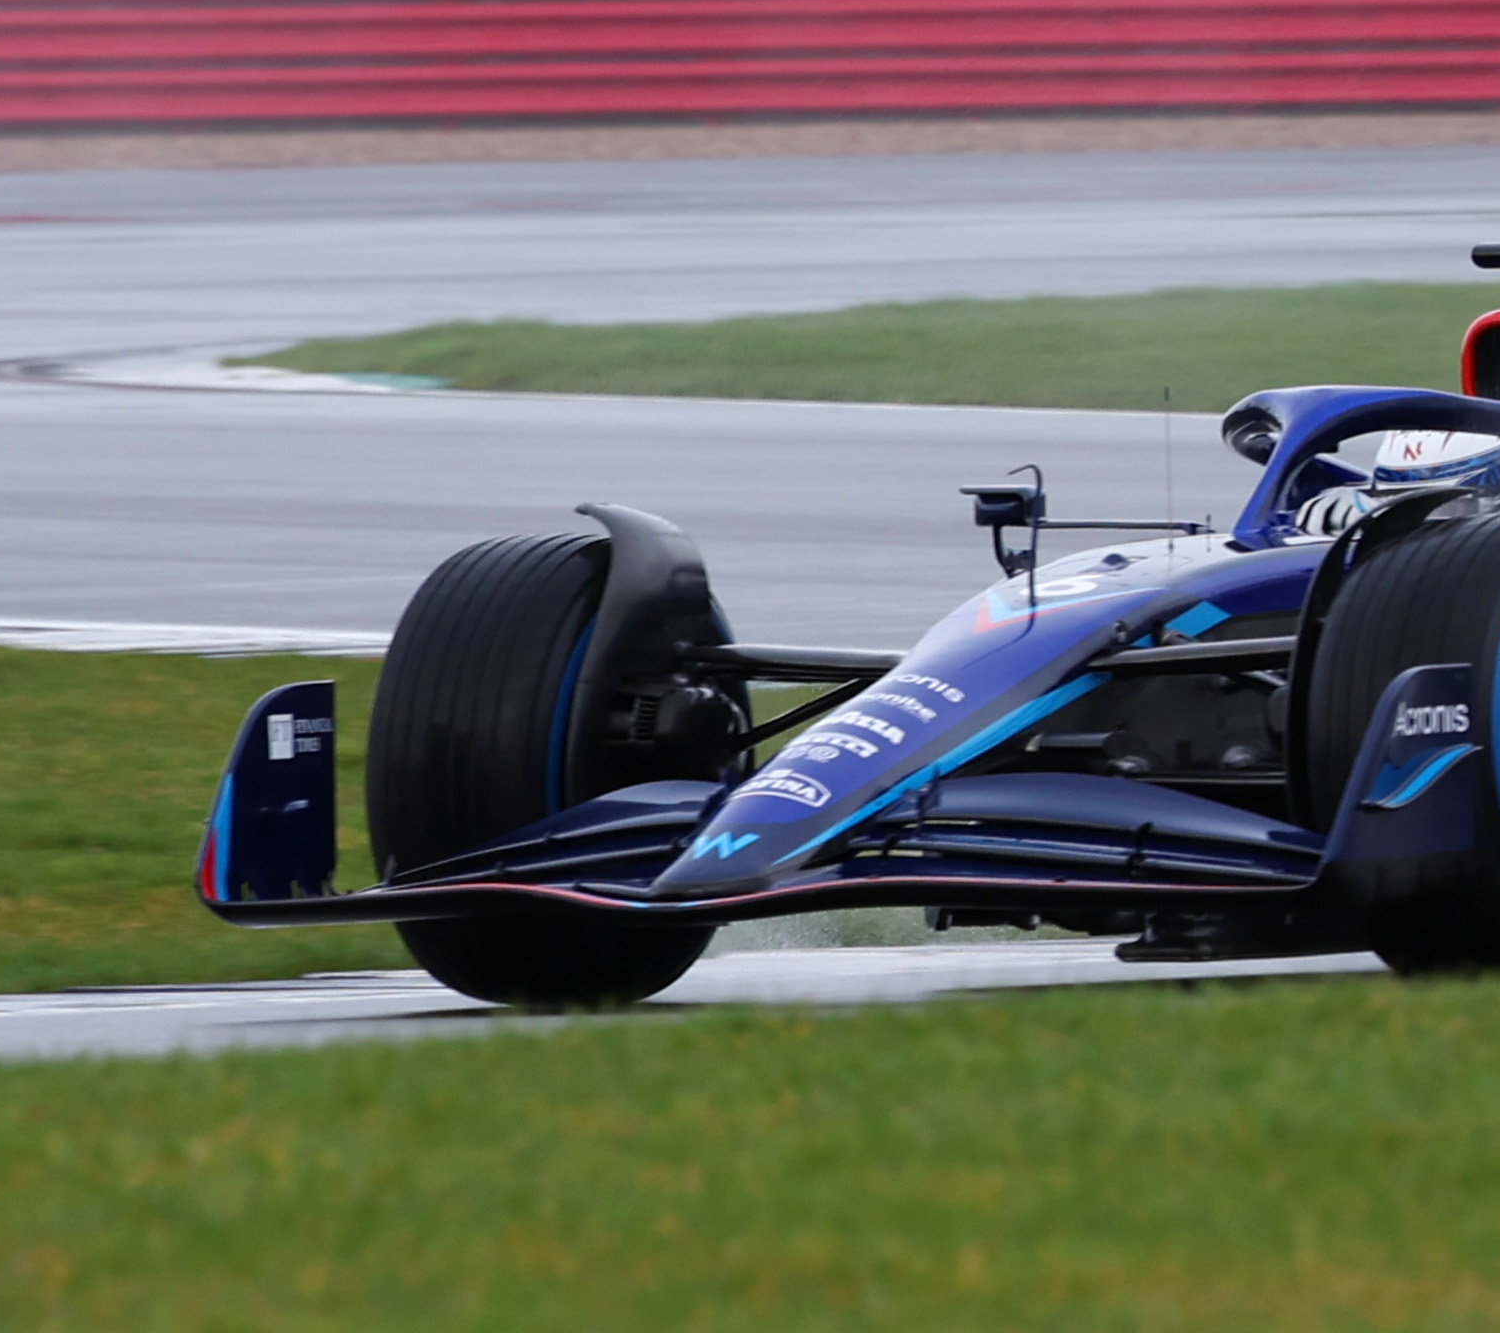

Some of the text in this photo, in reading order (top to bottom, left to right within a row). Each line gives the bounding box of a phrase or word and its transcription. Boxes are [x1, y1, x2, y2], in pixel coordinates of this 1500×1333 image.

[893, 673, 966, 704] onis
[1391, 702, 1471, 737] Acronis
[787, 732, 879, 759] RELLI
